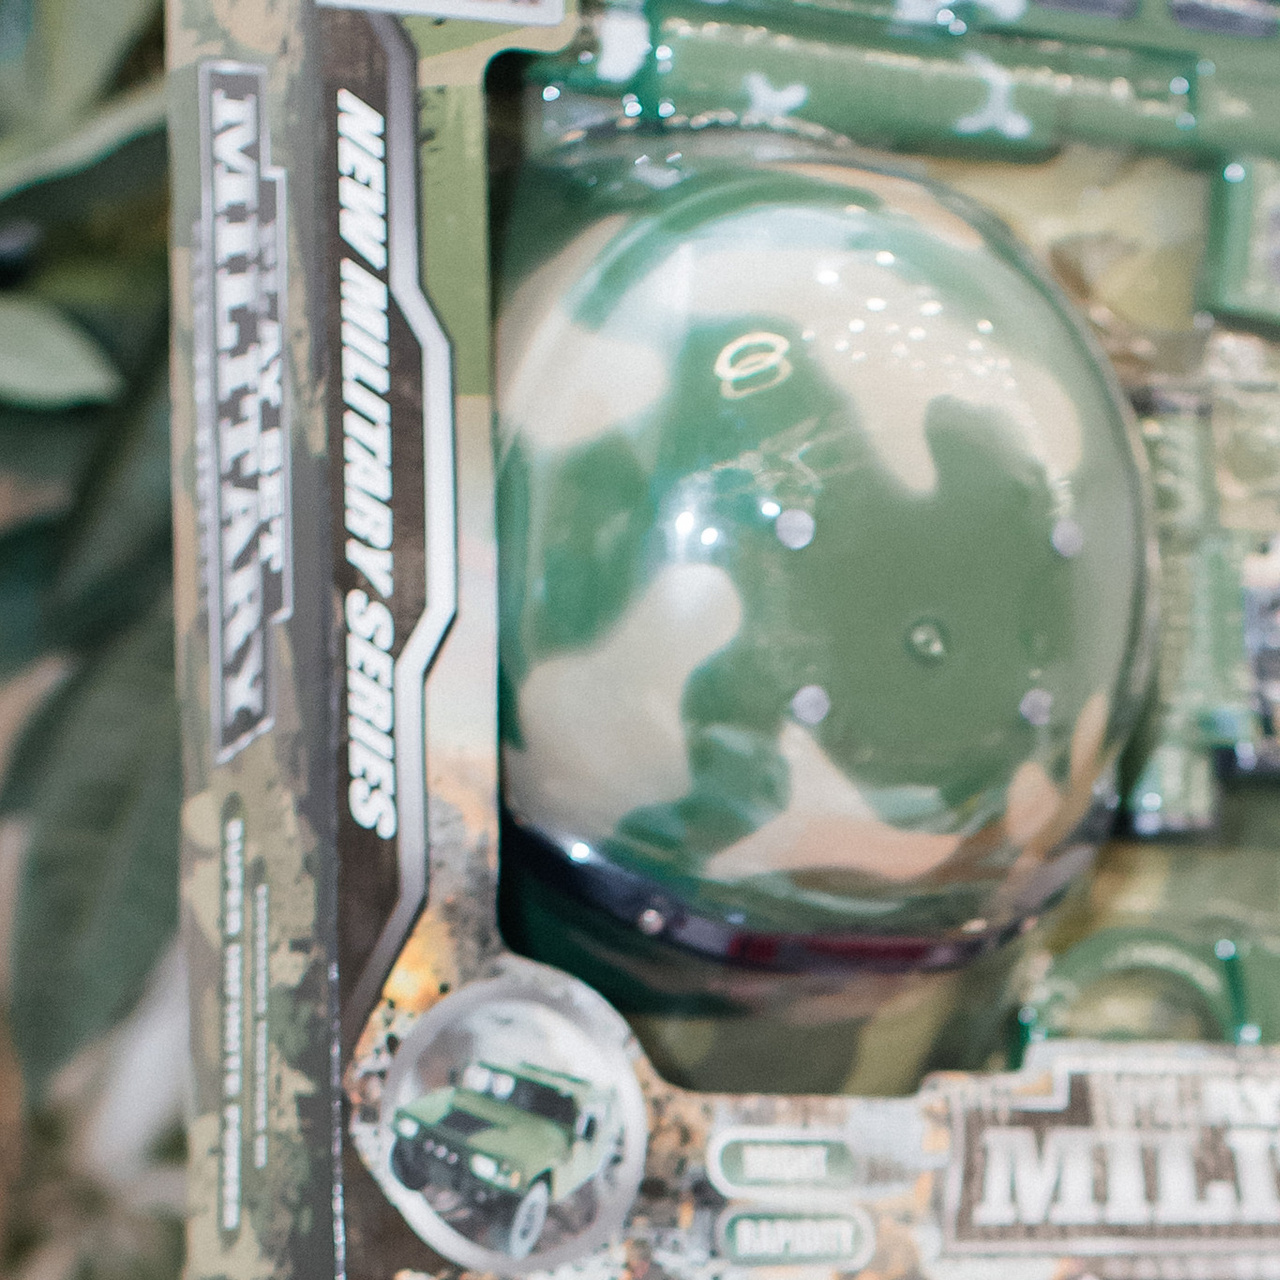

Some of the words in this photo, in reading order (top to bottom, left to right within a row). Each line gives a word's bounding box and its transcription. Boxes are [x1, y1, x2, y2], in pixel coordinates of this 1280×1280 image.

[336, 88, 388, 268] NEW
[210, 86, 268, 714] MILITARY
[340, 257, 393, 598] MILITARY
[345, 588, 397, 840] SERIES
